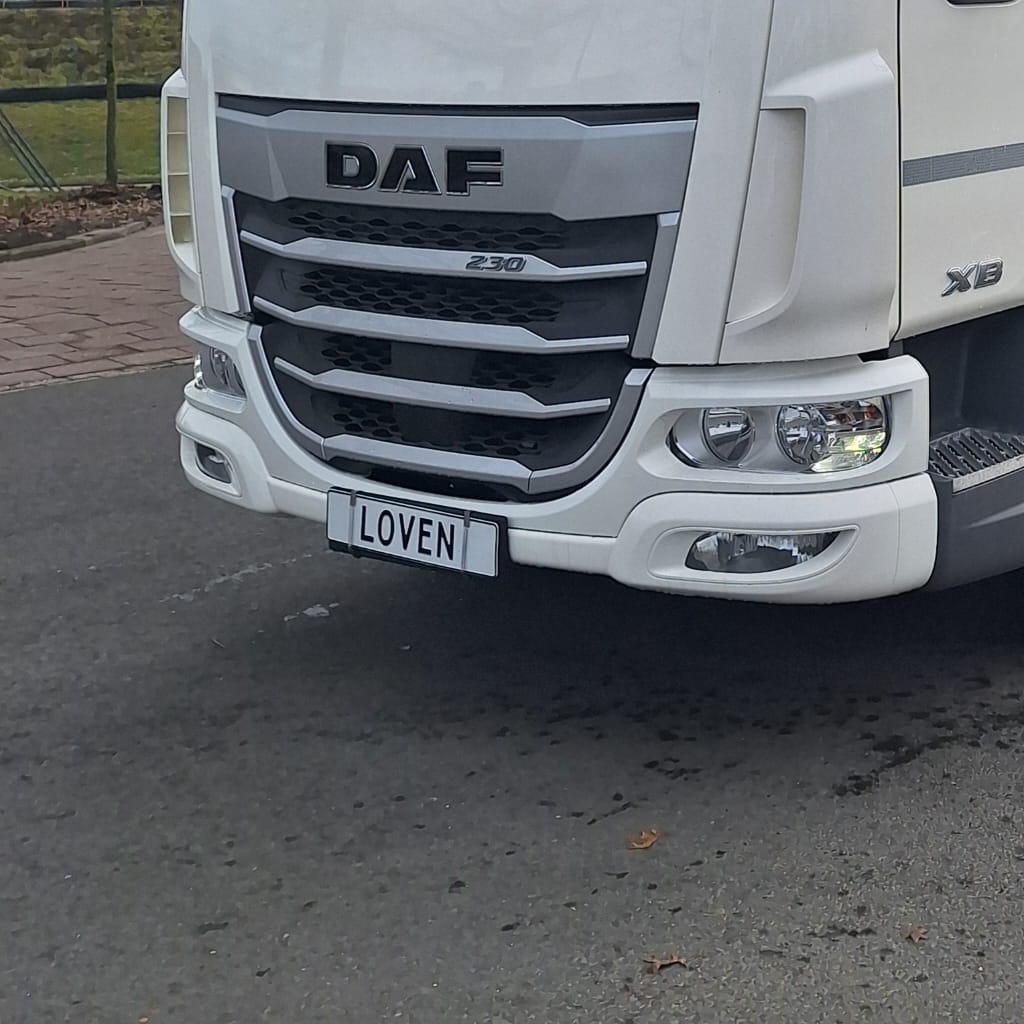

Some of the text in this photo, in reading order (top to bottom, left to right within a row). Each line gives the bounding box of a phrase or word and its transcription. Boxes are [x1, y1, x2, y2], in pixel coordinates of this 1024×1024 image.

[325, 141, 504, 196] DAF
[465, 255, 527, 273] 230
[941, 258, 1003, 297] XB
[360, 505, 455, 561] LOVEN
